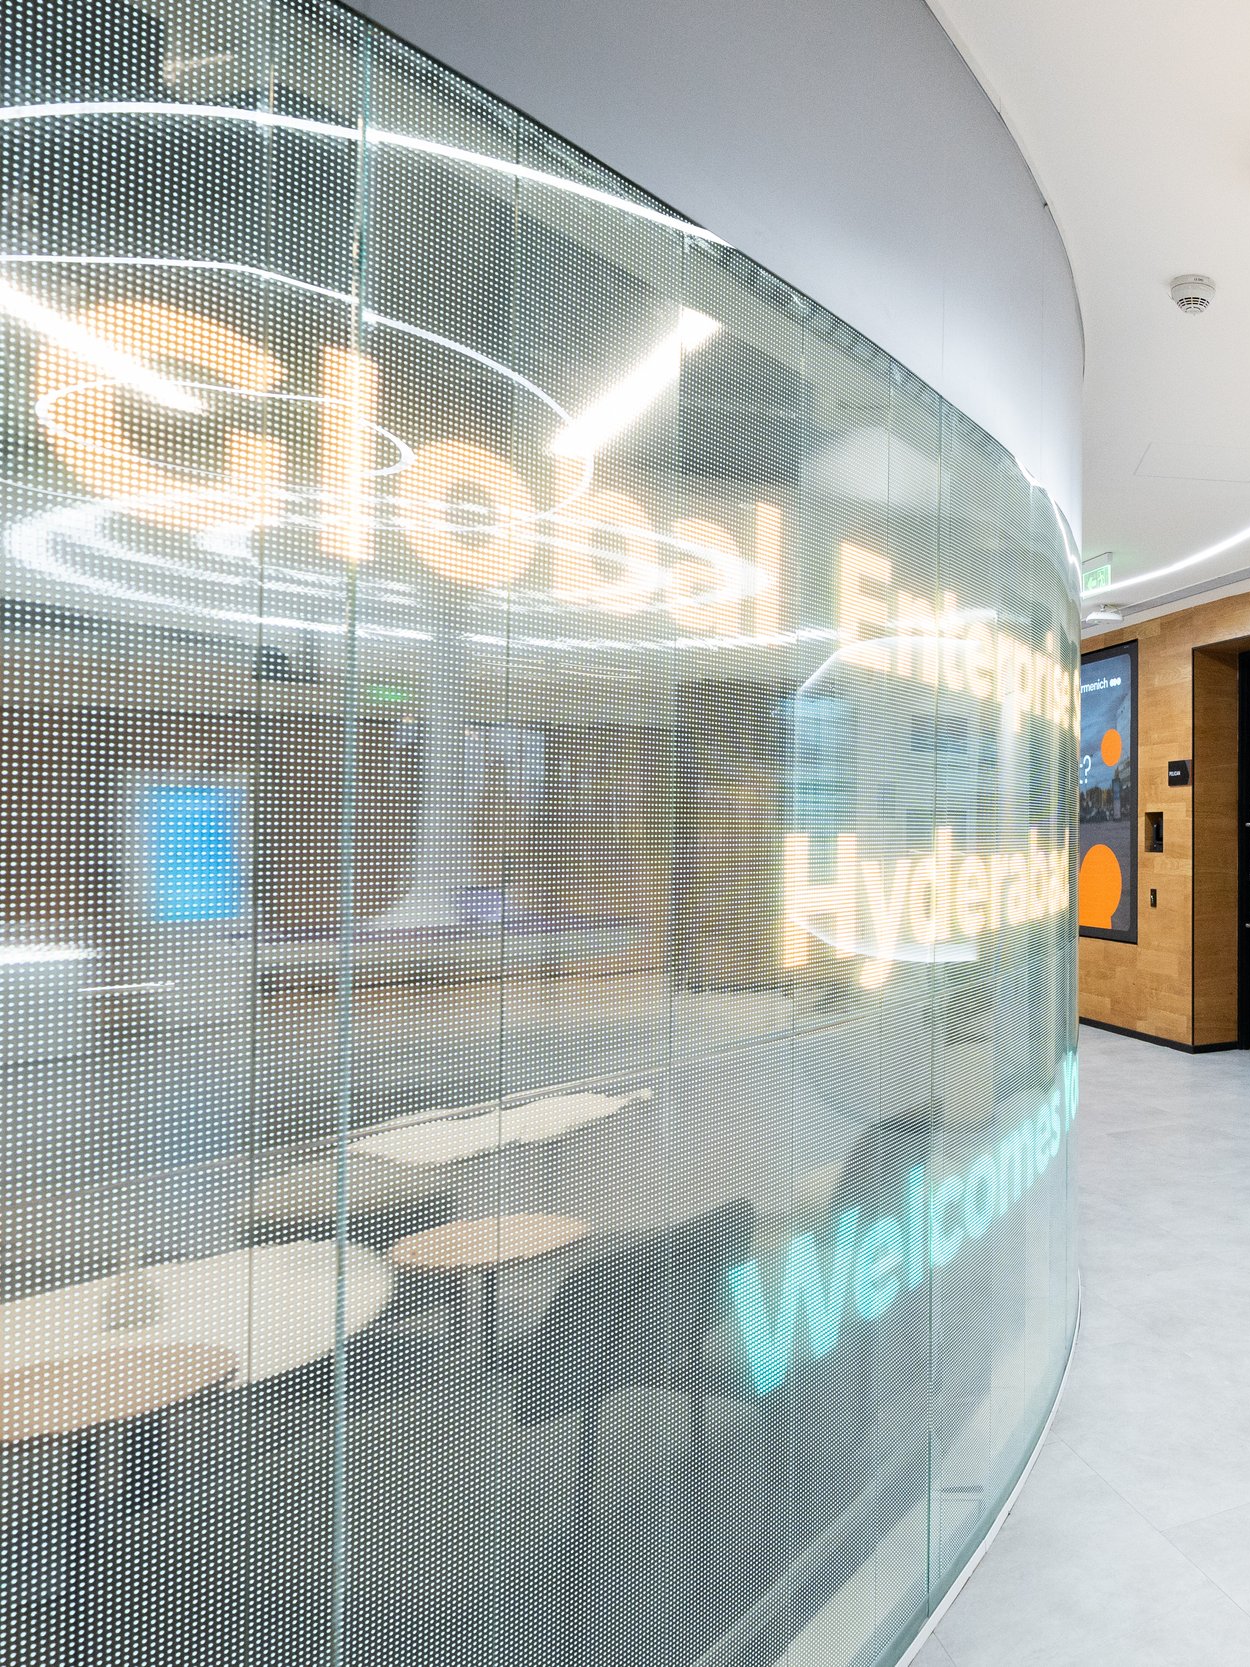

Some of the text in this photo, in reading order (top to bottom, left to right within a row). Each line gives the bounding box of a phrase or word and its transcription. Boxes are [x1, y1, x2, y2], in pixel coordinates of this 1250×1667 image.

[34, 300, 783, 637] Global
[1080, 677, 1108, 694] rmenich
[781, 826, 1069, 988] Hyderabad
[728, 1088, 1061, 1396] Welcomes
